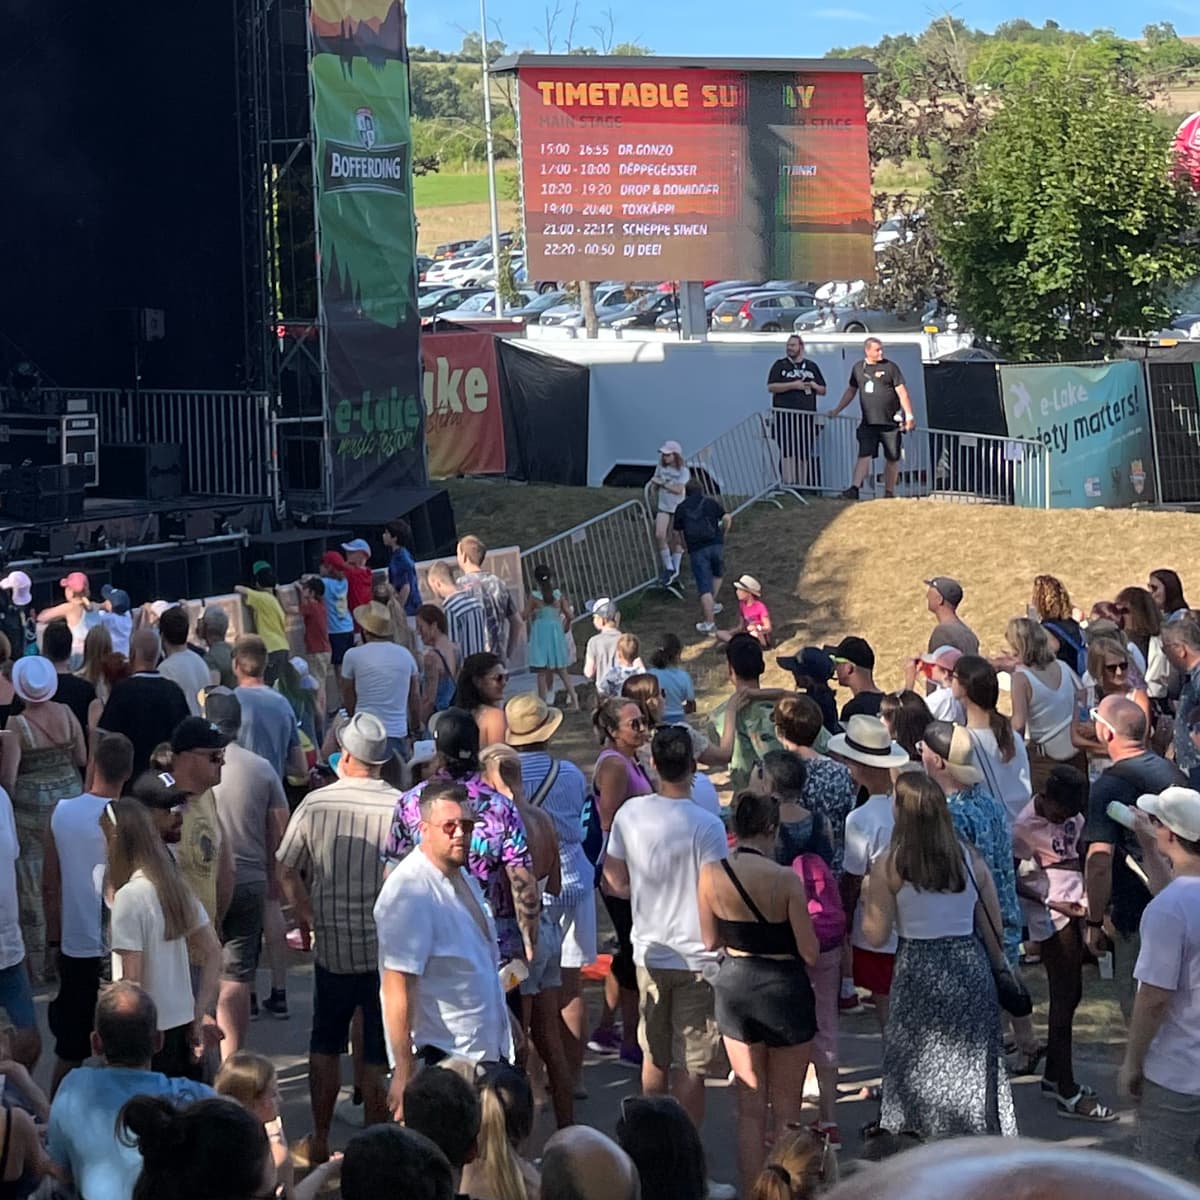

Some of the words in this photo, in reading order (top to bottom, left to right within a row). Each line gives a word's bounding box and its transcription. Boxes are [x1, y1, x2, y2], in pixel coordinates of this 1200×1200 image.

[537, 81, 688, 108] TIMETABLE
[579, 115, 623, 128] STAGE
[331, 152, 401, 179] BOFFERDING
[335, 386, 419, 434] e-Lake
[1040, 381, 1089, 416] e-Lake
[1073, 384, 1140, 441] matters!
